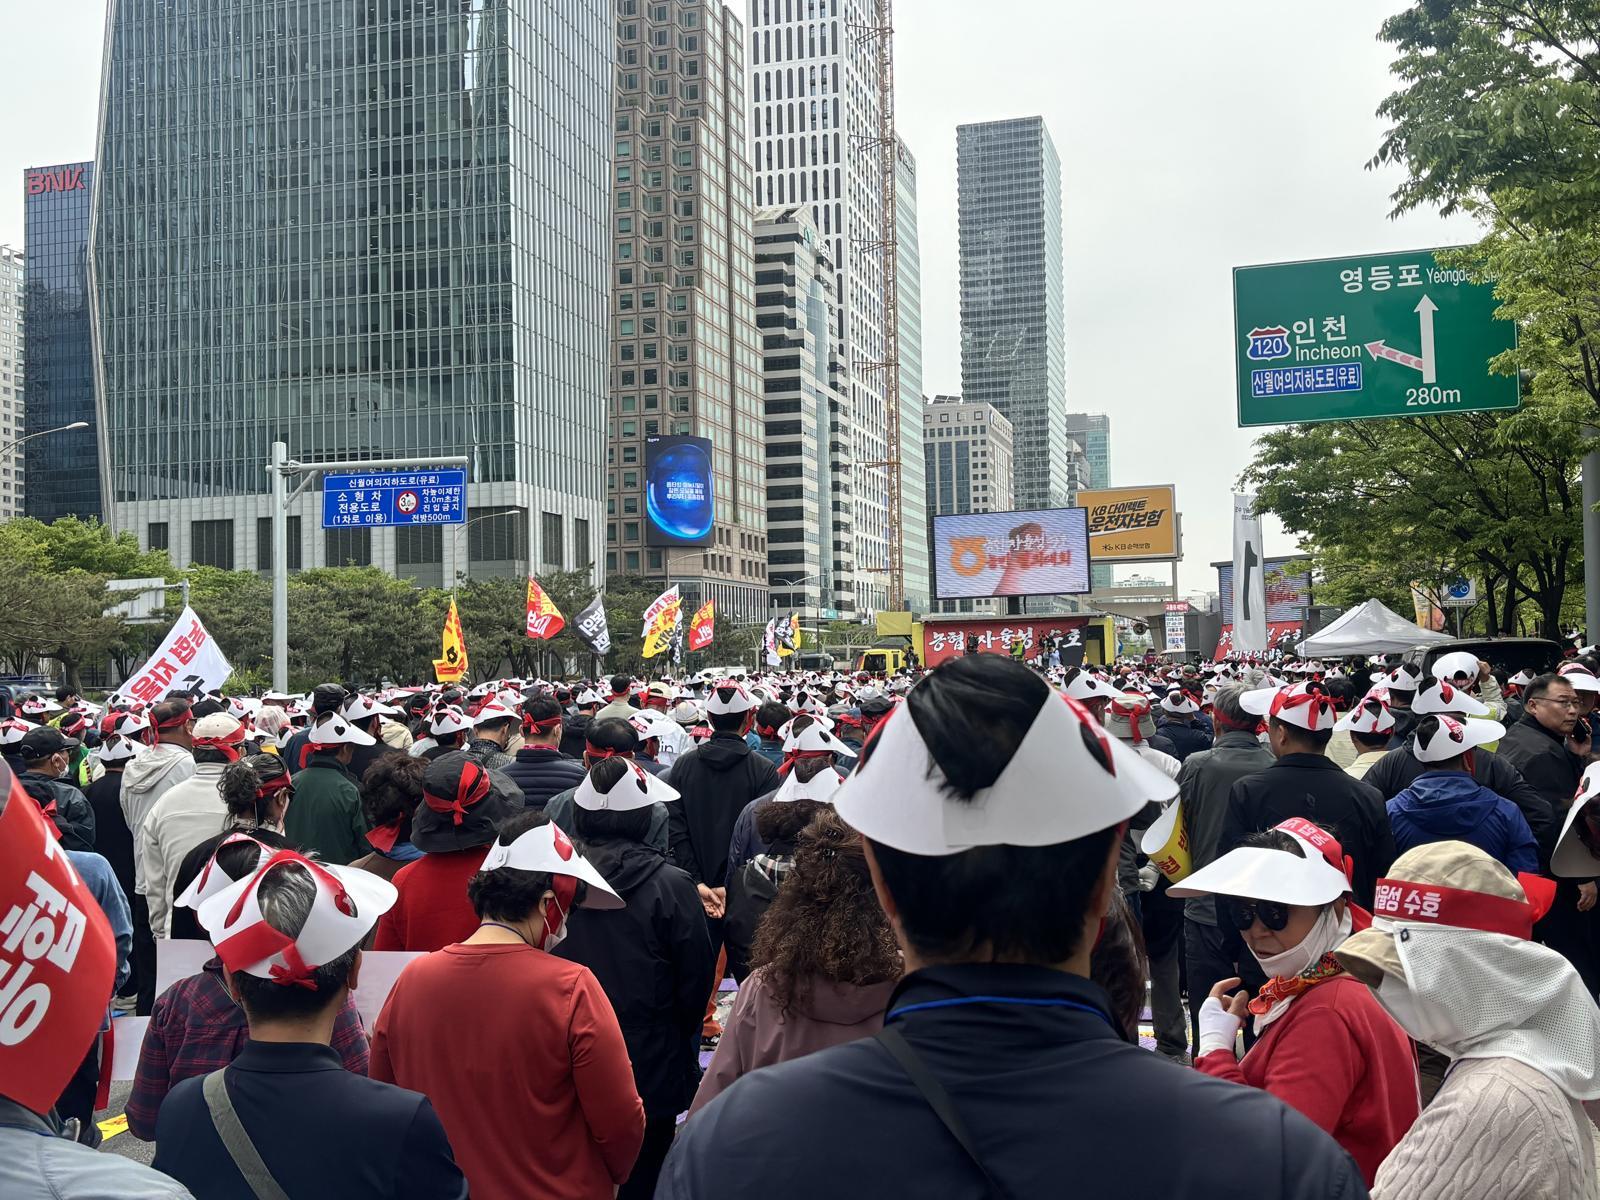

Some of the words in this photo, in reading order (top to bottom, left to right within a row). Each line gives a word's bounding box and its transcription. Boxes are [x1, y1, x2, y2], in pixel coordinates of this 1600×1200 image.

[28, 167, 85, 195] BNK
[1339, 264, 1423, 294] 영등포
[1292, 315, 1347, 344] 인천
[1254, 338, 1283, 355] 120
[1295, 344, 1361, 362] Incheon
[1253, 370, 1360, 395] 신월여의지하도로(유료)
[1406, 387, 1461, 406] 280m
[348, 476, 440, 488] 신월여의지하도로(유료)
[422, 487, 461, 496] 차높이제한
[423, 495, 460, 504] 3.0m초과
[338, 502, 381, 513] 전용도로
[1091, 505, 1107, 517] KB
[1108, 500, 1148, 515] 다이렉트
[332, 514, 361, 524] (1차로
[365, 513, 388, 524] 이용)
[411, 512, 452, 522] 전방500m
[1089, 508, 1166, 533] 운전자보험
[928, 630, 965, 652] 농협
[1375, 885, 1402, 912] 율성
[1404, 889, 1442, 918] 수호
